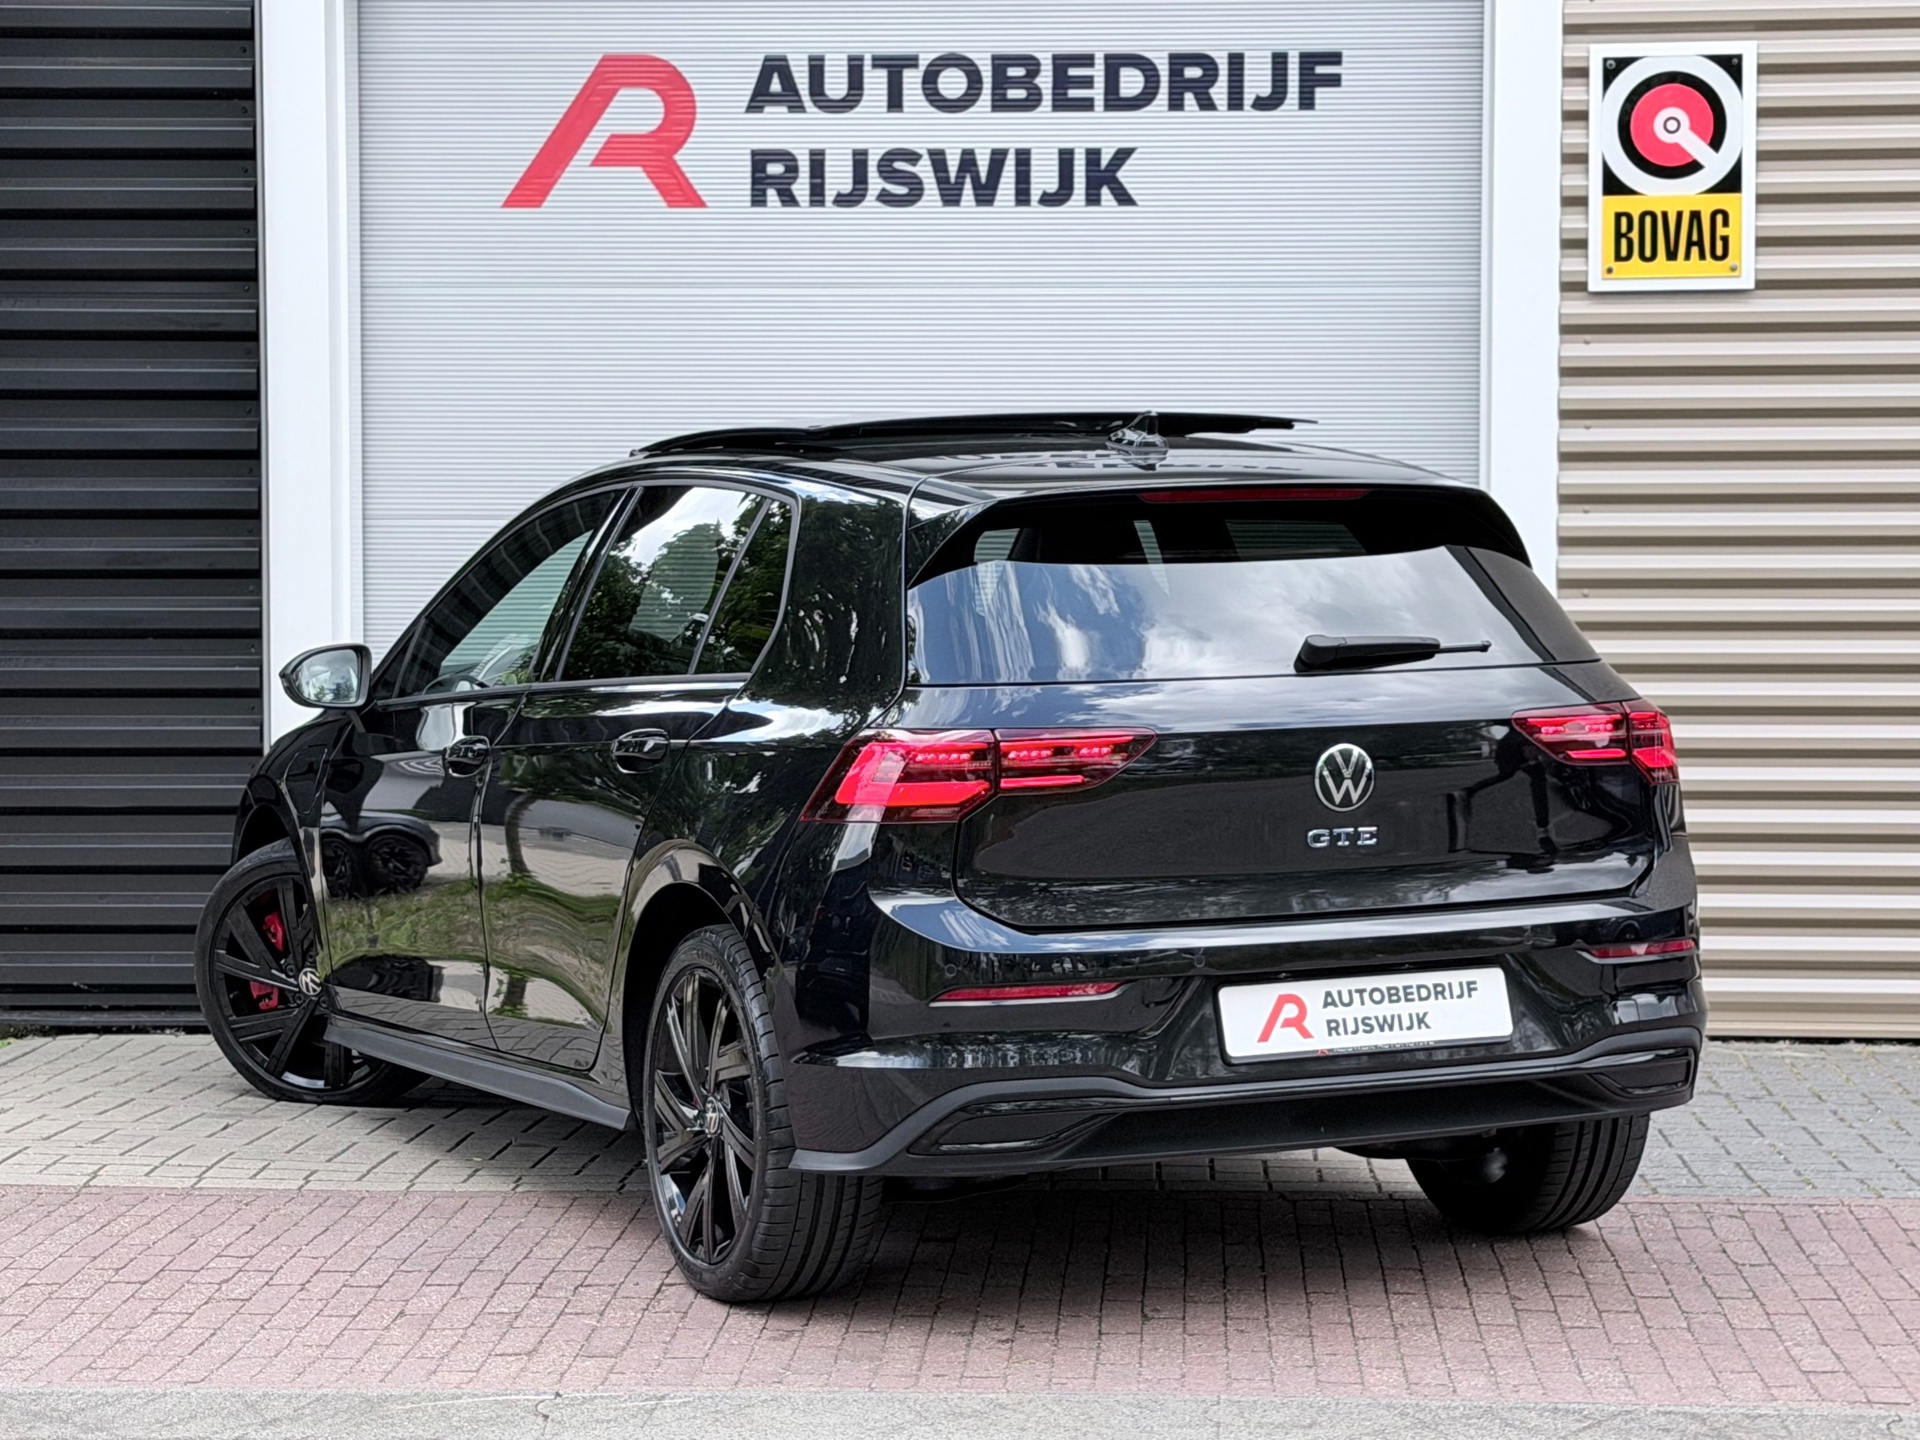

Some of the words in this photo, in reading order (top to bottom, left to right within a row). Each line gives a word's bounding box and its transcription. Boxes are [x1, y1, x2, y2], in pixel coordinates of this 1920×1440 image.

[746, 51, 1343, 113] AUTOBEDRIJF
[751, 147, 1138, 208] RIJSWIJK
[1613, 208, 1731, 263] BOVAG
[1307, 826, 1378, 848] GTE
[1321, 980, 1478, 1009] AUTOBEDRIJF
[1325, 1011, 1431, 1037] RIJSWIJK
